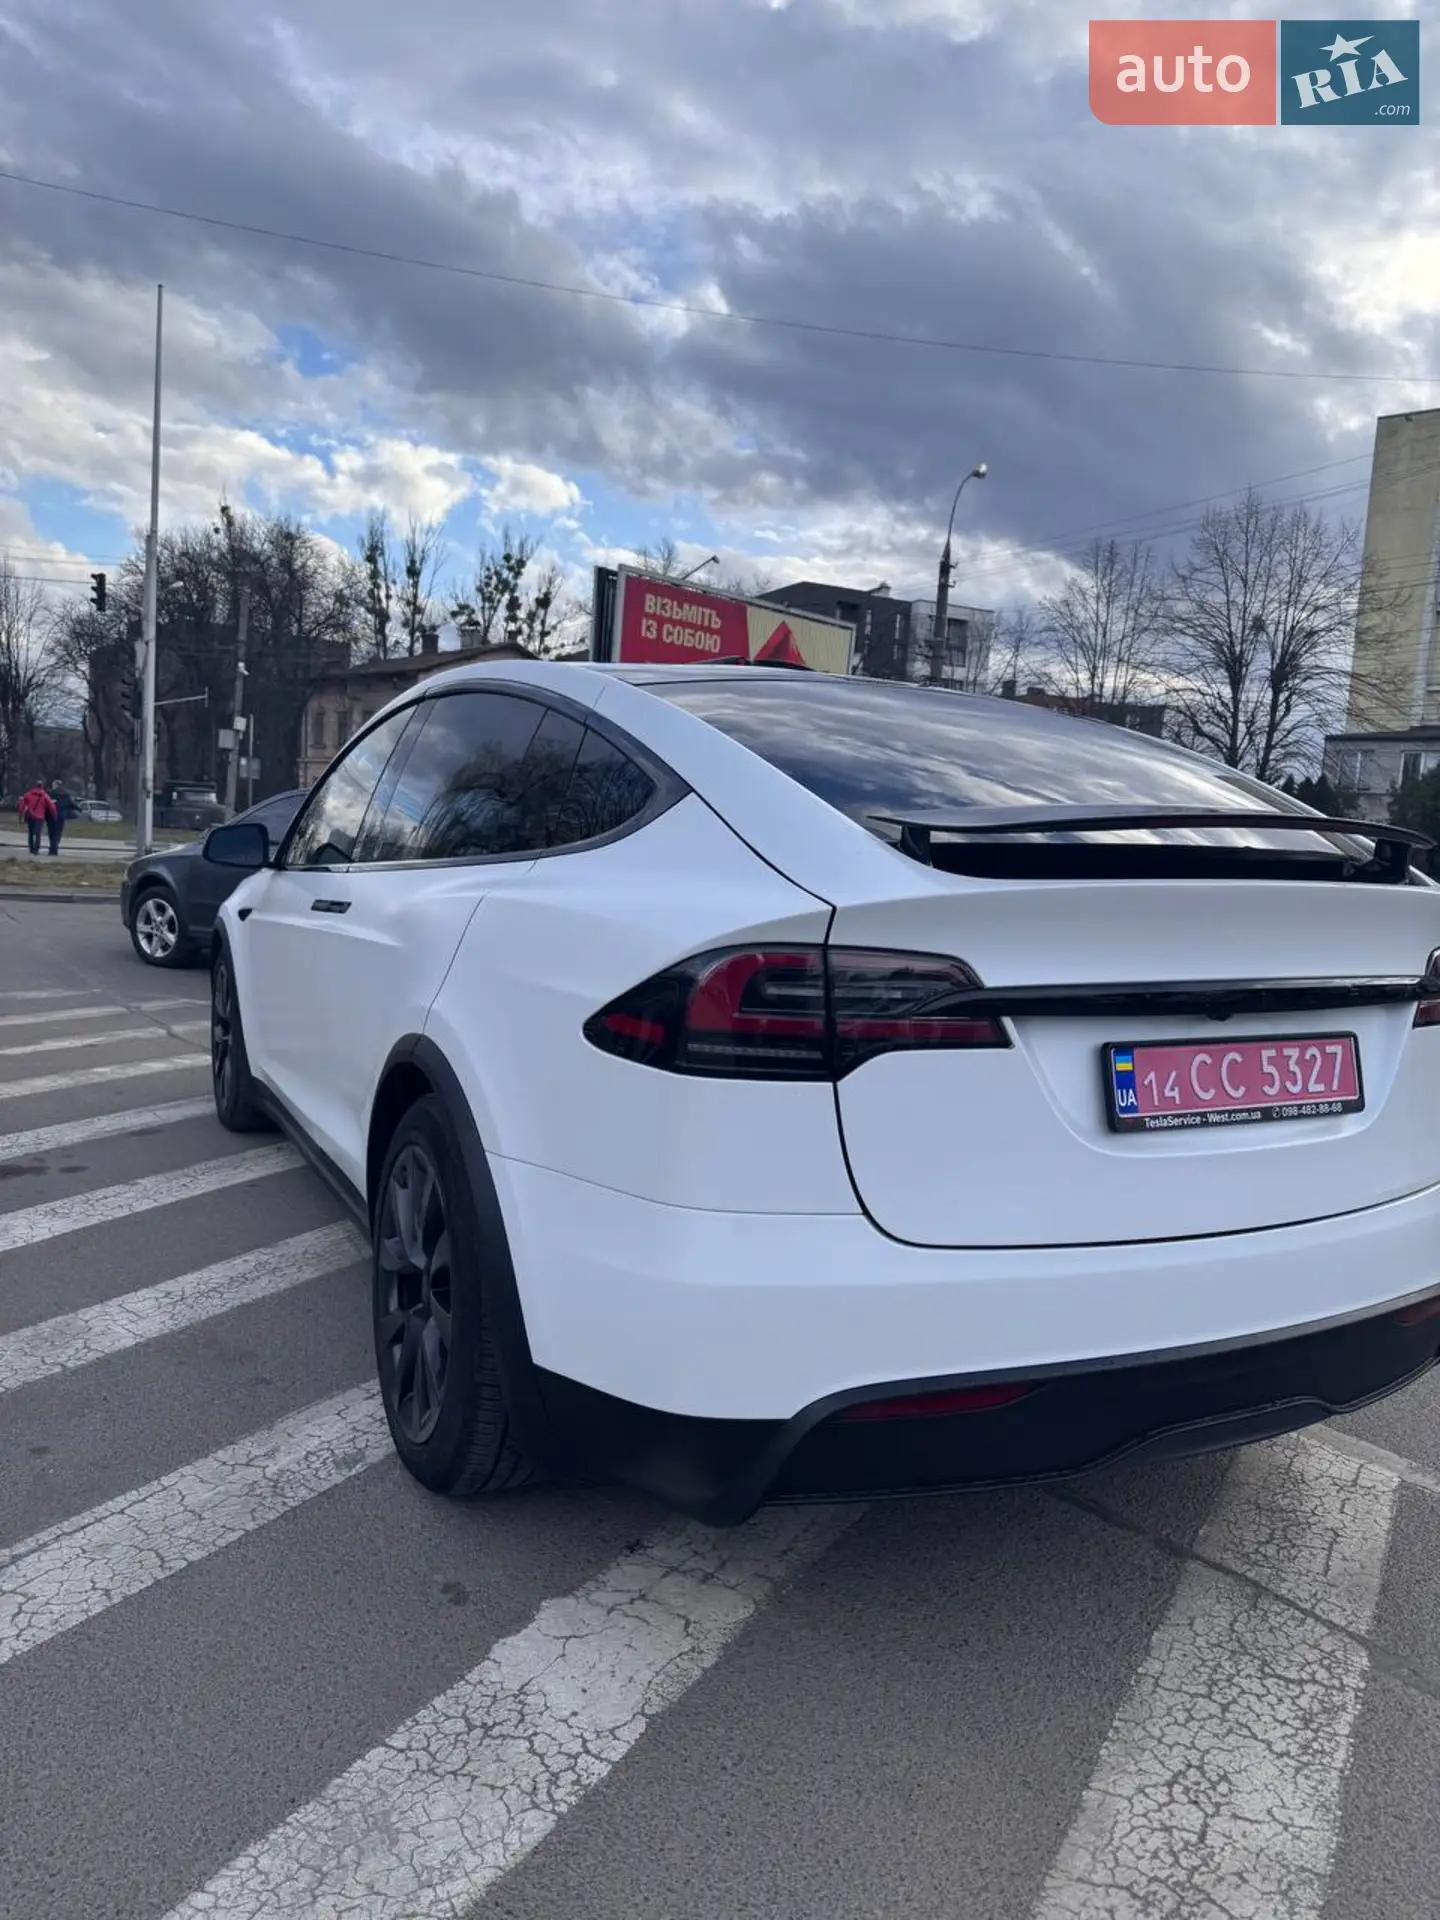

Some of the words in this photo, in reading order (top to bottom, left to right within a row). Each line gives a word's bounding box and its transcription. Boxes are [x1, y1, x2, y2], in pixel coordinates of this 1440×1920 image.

[644, 593, 722, 629] ВІЗЬМІТЬ
[641, 617, 658, 639] ІЗ
[662, 623, 722, 654] СОБОЮ
[1143, 1070, 1181, 1107] 14
[1190, 1051, 1246, 1101] CC
[1260, 1044, 1343, 1096] 5327
[1117, 1088, 1138, 1107] UA
[1144, 1114, 1202, 1129] TeslaService
[1207, 1109, 1262, 1124] West.com.ua
